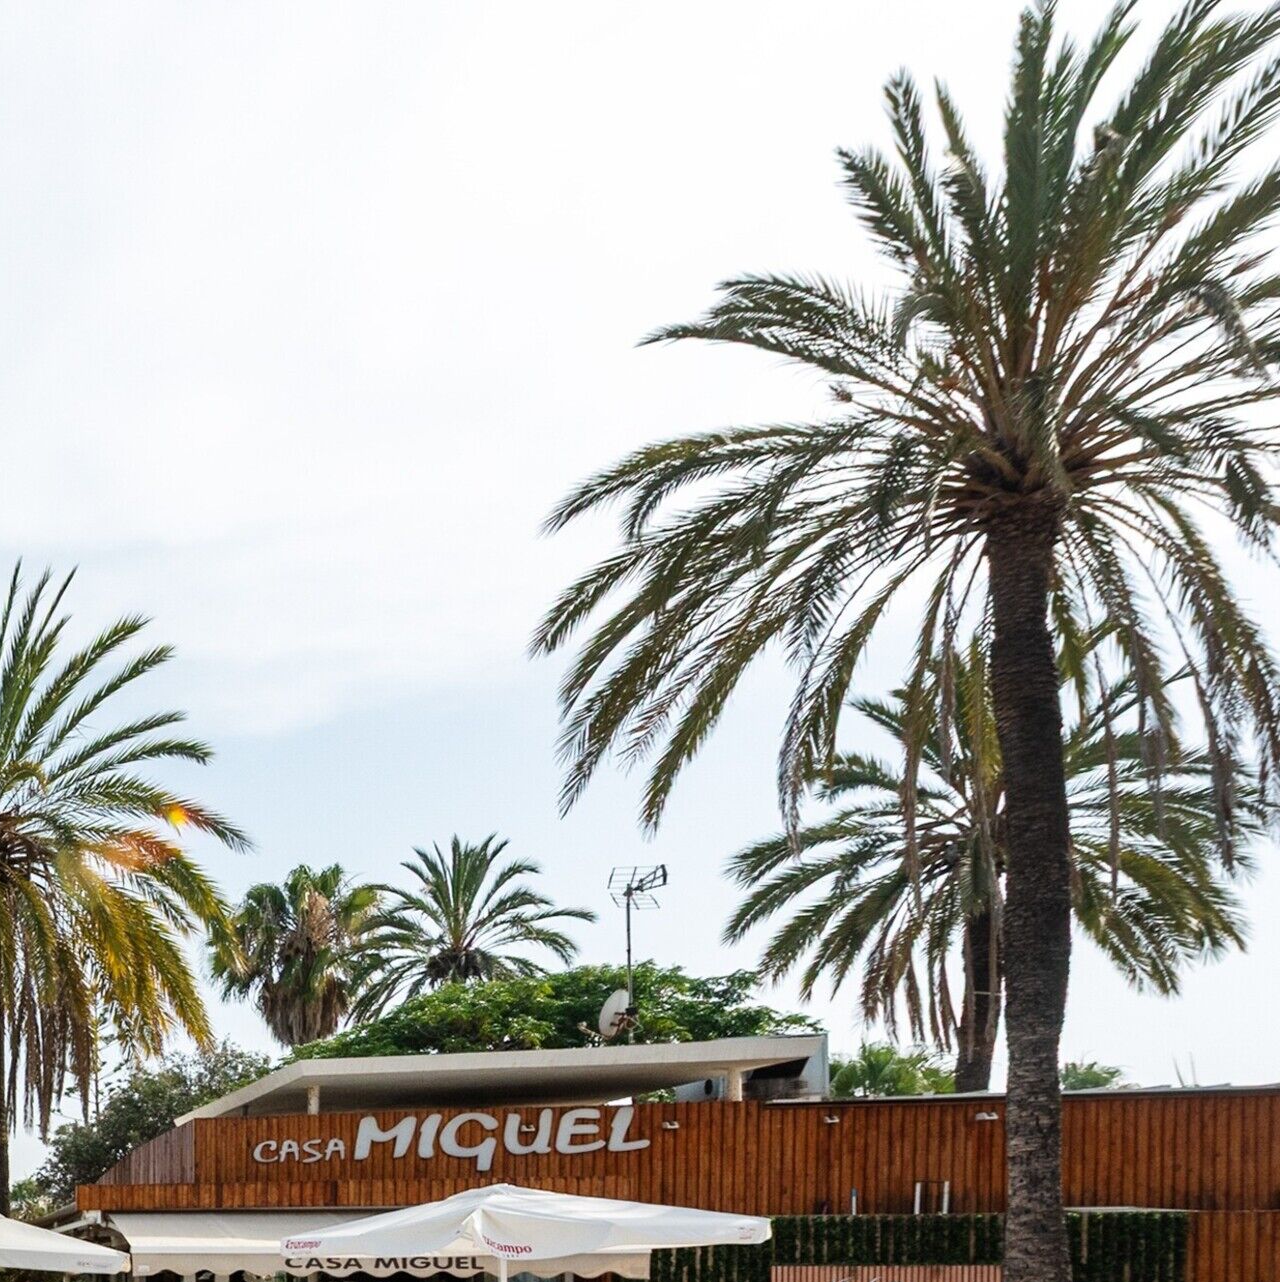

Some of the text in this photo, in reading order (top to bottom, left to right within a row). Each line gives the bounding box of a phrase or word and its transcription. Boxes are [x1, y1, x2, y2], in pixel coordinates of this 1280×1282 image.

[252, 1107, 650, 1172] CASA MIGUEL
[284, 1257, 484, 1270] CASA MIGUEL
